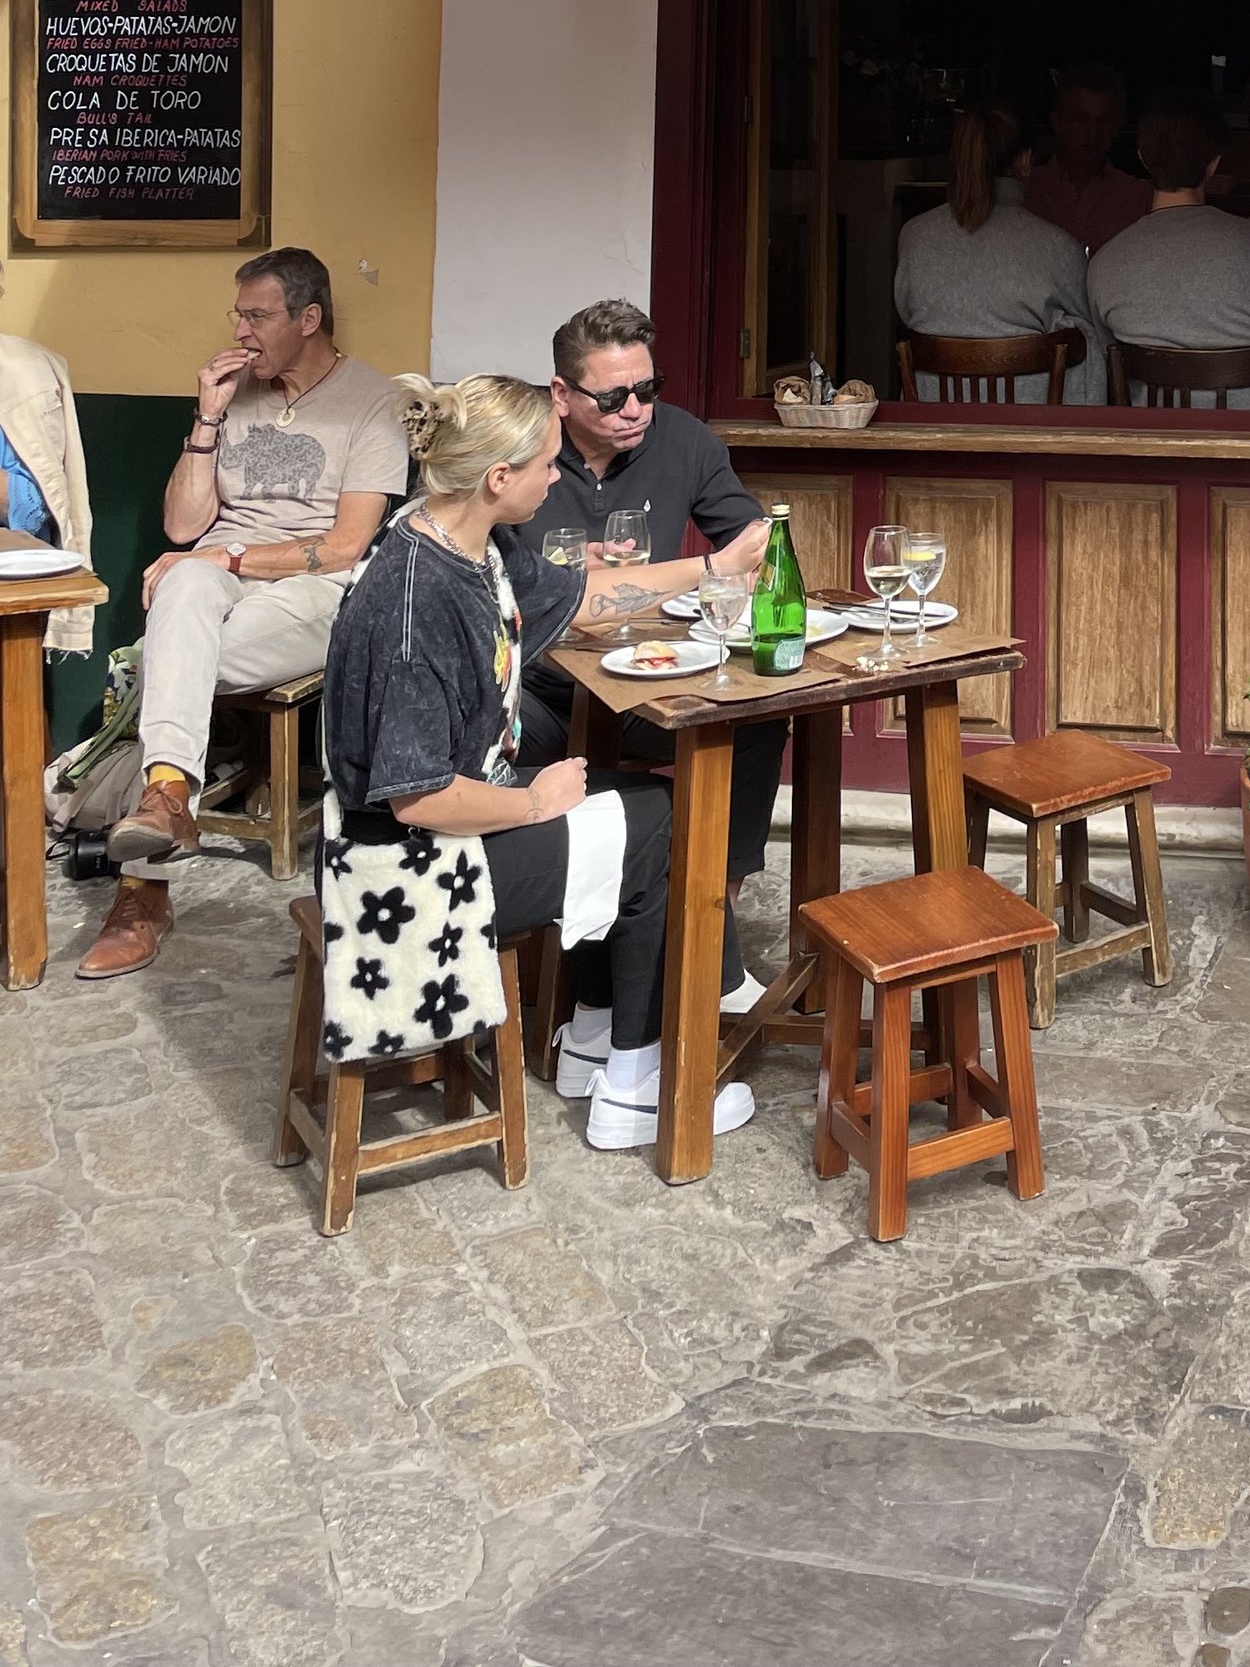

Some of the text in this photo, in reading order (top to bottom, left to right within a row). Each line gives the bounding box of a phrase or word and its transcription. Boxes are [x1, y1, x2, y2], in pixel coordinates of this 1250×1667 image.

[76, 0, 188, 12] MIXED SALADS
[46, 39, 77, 49] FRIED
[83, 38, 111, 48] EGGS
[184, 37, 239, 48] POTATOES
[46, 54, 229, 73] CROQUETAS DE JAMON
[111, 75, 187, 86] CROQUETTES
[48, 91, 202, 110] COLA DE TORO
[76, 113, 152, 125] BULL'S TAIL
[49, 128, 109, 147] PRESA
[52, 150, 97, 161] IBERIAN
[100, 150, 127, 161] PORK
[158, 150, 186, 161] FRIES
[48, 166, 120, 185] PESCADO
[125, 167, 171, 184] FRITO
[64, 186, 194, 199] FRIED FISH PLATTER
